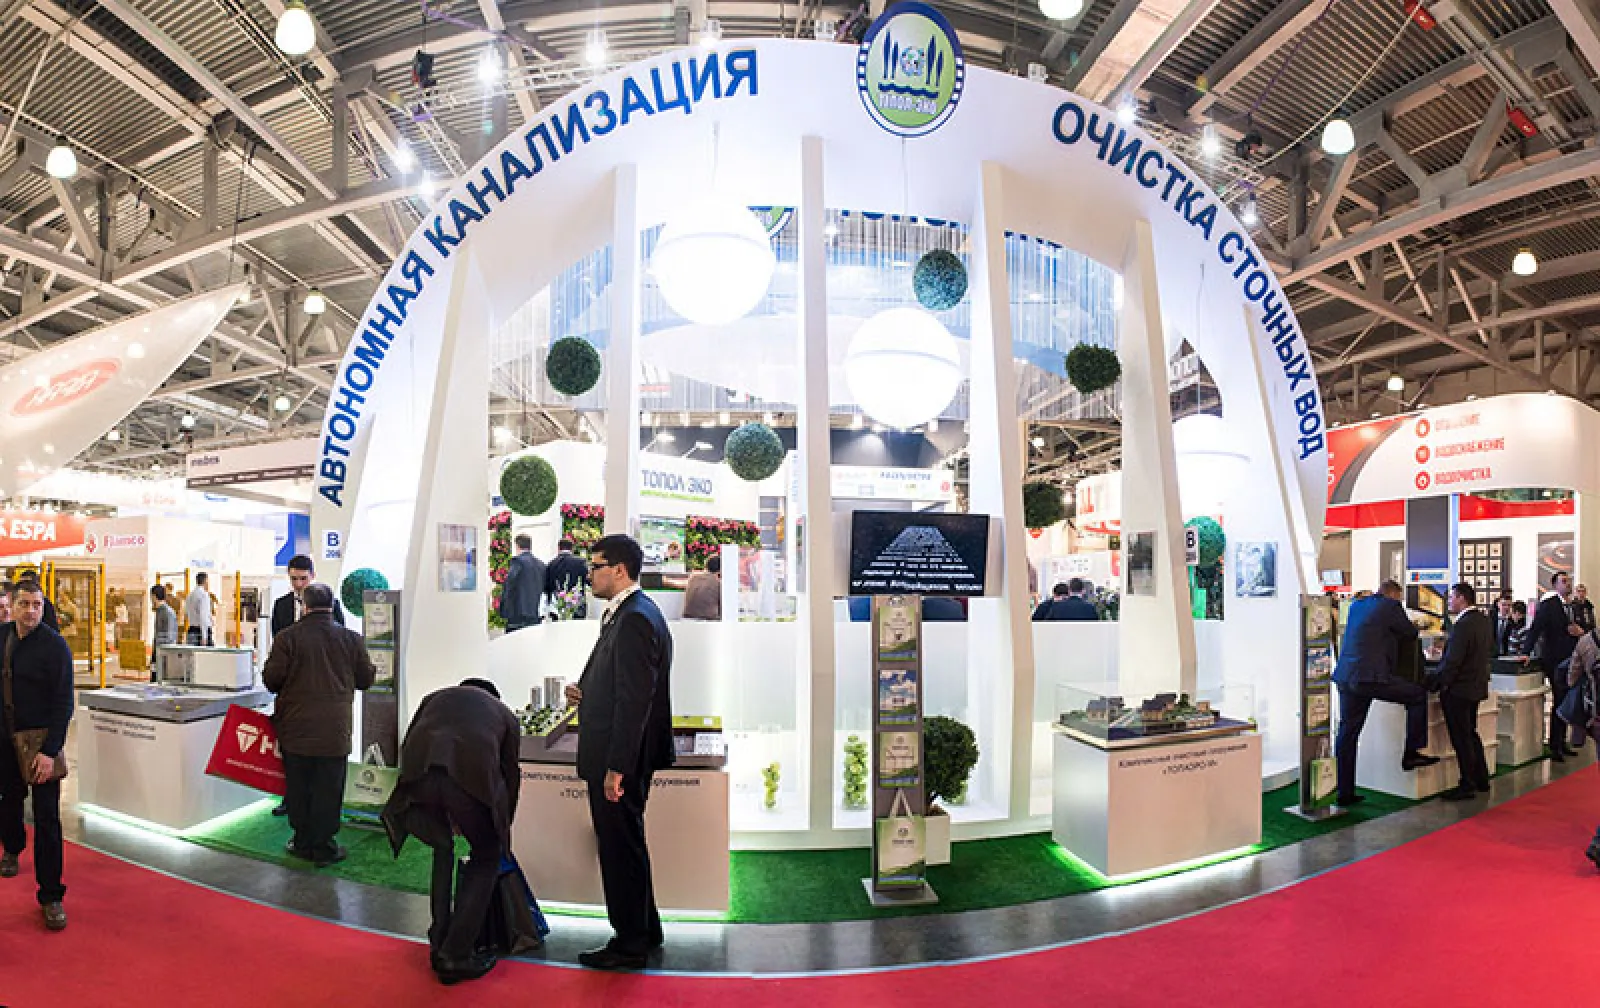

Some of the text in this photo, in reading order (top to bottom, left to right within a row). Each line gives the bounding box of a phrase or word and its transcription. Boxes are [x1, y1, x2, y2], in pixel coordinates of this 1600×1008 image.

[319, 49, 759, 507] АВТОНОМНАЯ КАНАЛИЗАЦИЯ
[1052, 101, 1325, 461] ОЧИСТКА СТОЧНЫХ ВОД
[687, 477, 713, 495] ЭКО
[9, 519, 57, 542] ESPA
[327, 531, 340, 547] B
